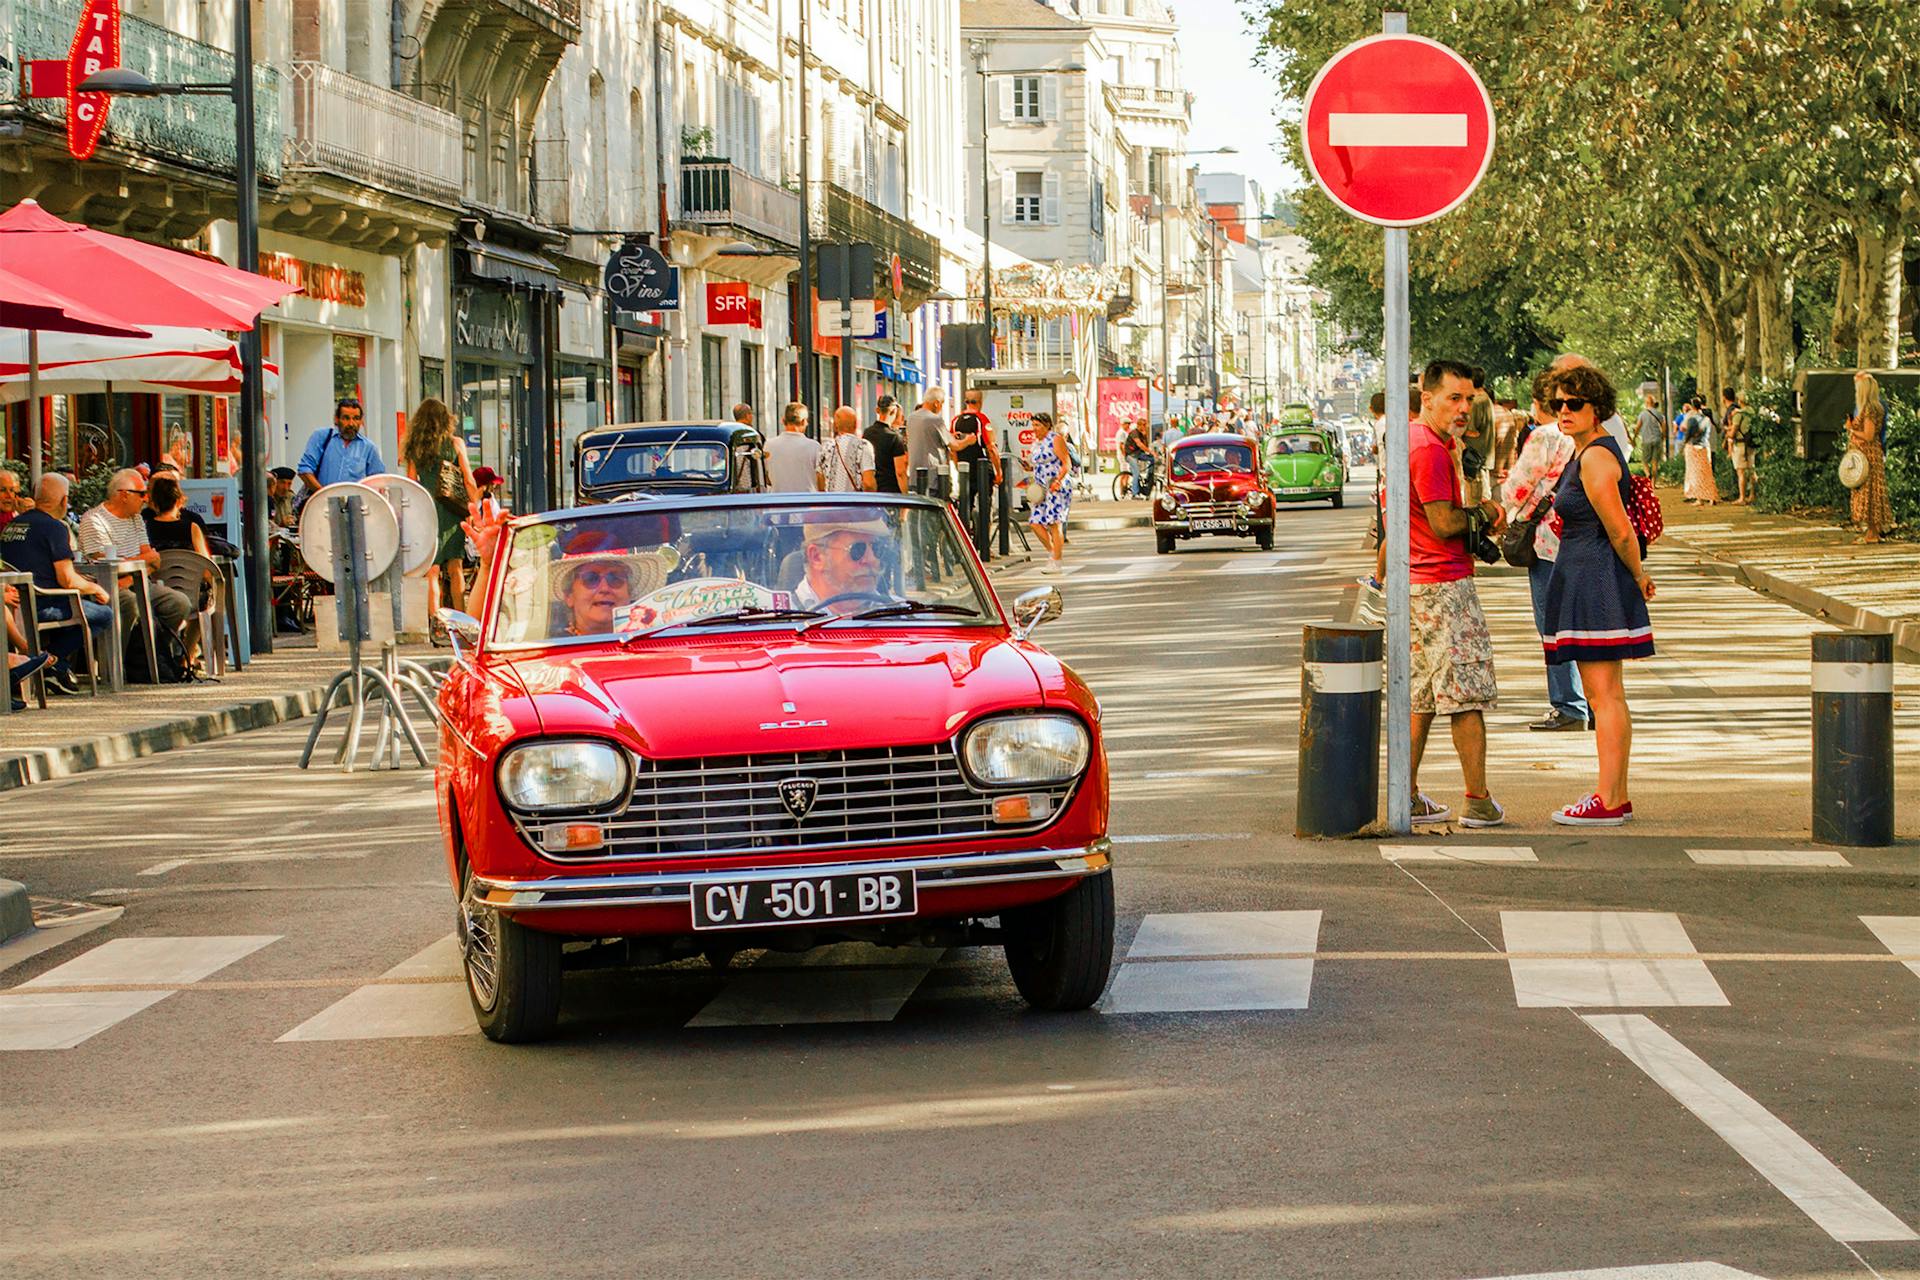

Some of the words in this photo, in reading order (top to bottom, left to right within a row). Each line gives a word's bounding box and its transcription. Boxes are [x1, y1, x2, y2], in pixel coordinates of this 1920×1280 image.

[76, 13, 108, 122] TABC
[619, 247, 653, 268] La
[608, 273, 663, 298] Vins
[715, 295, 747, 311] SFR
[759, 720, 828, 729] 204
[705, 884, 749, 922] CV
[857, 875, 901, 912] BB
